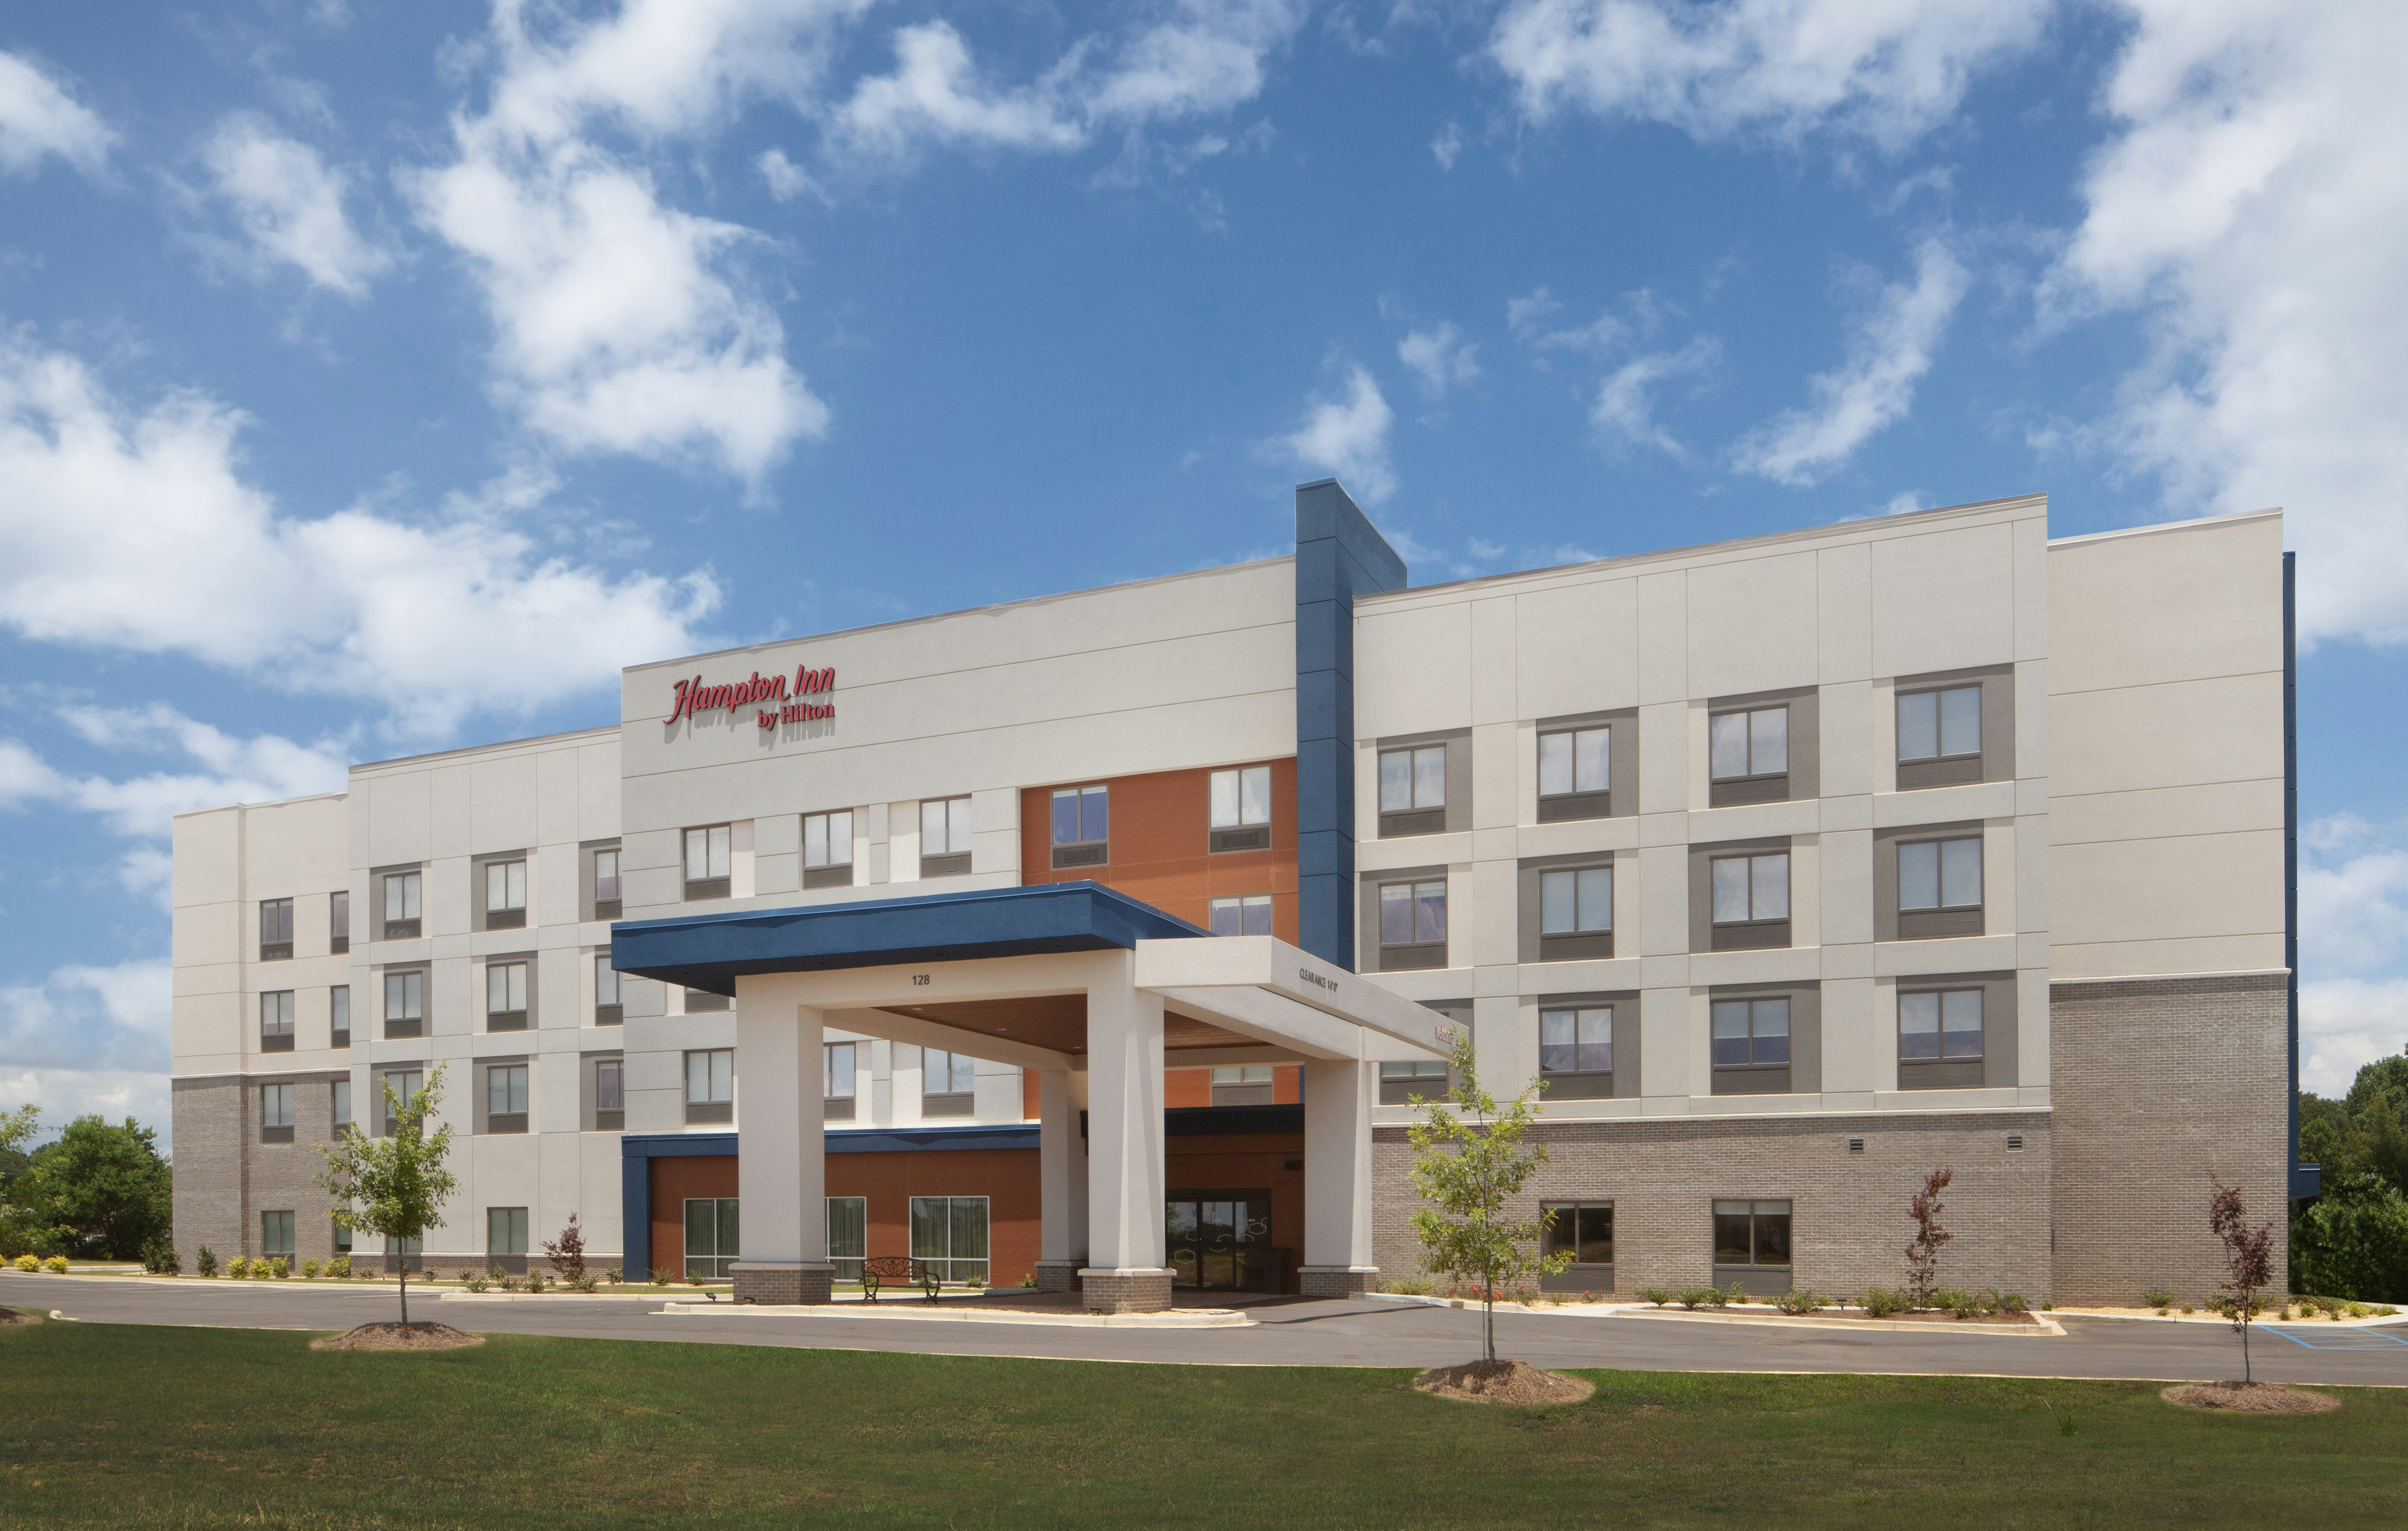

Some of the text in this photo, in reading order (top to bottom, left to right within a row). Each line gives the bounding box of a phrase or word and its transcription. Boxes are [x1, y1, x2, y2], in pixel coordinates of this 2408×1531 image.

[663, 664, 835, 724] Hampton Inn
[757, 703, 835, 731] by Hilton
[912, 974, 930, 985] 128
[1300, 968, 1326, 988] CLEARANCE
